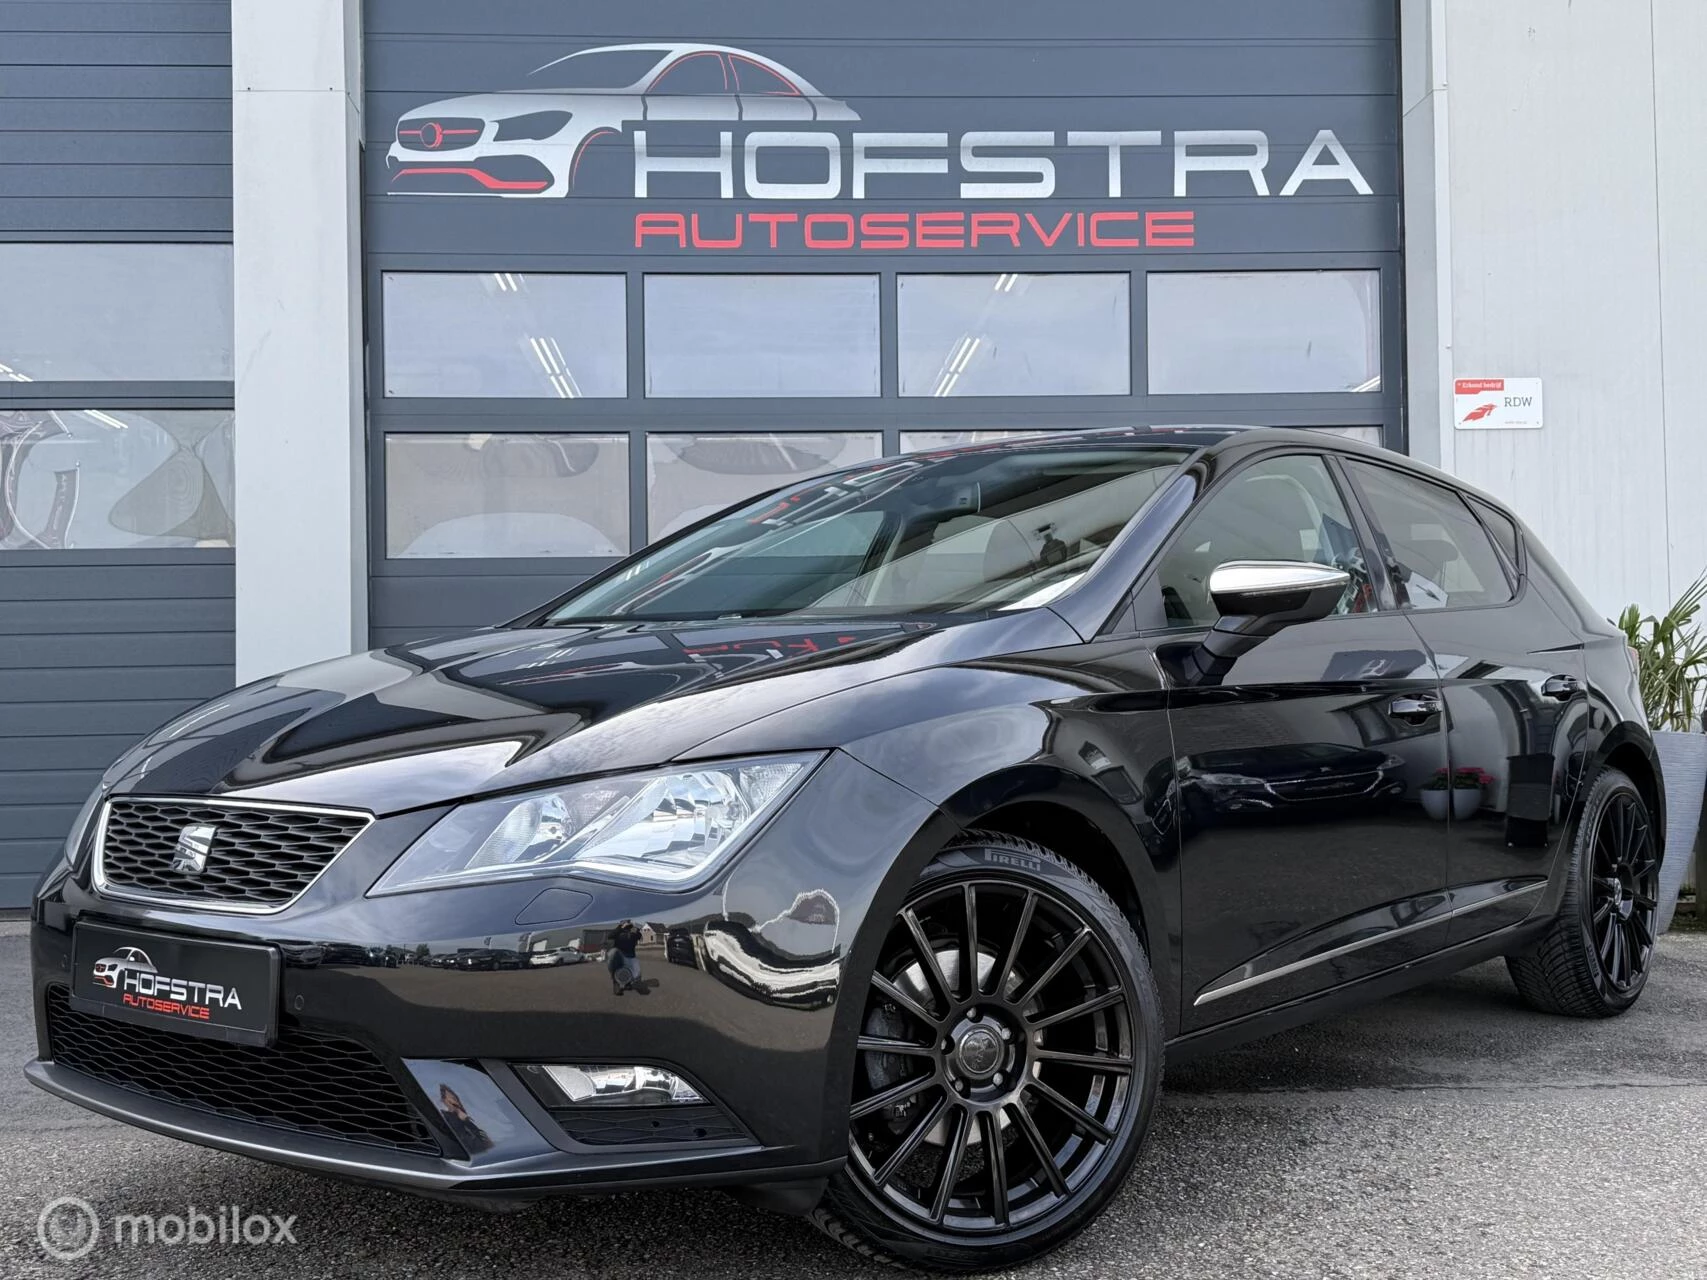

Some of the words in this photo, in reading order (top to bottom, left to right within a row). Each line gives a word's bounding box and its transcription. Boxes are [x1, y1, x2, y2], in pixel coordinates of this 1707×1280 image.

[633, 128, 1374, 200] HOFSTRA
[634, 211, 1195, 250] AUTOSERVICE
[1503, 396, 1533, 408] RDW
[984, 848, 1041, 872] PIRELLI
[122, 993, 210, 1020] AUTOSERVICE
[123, 970, 242, 1010] HOFSTRA
